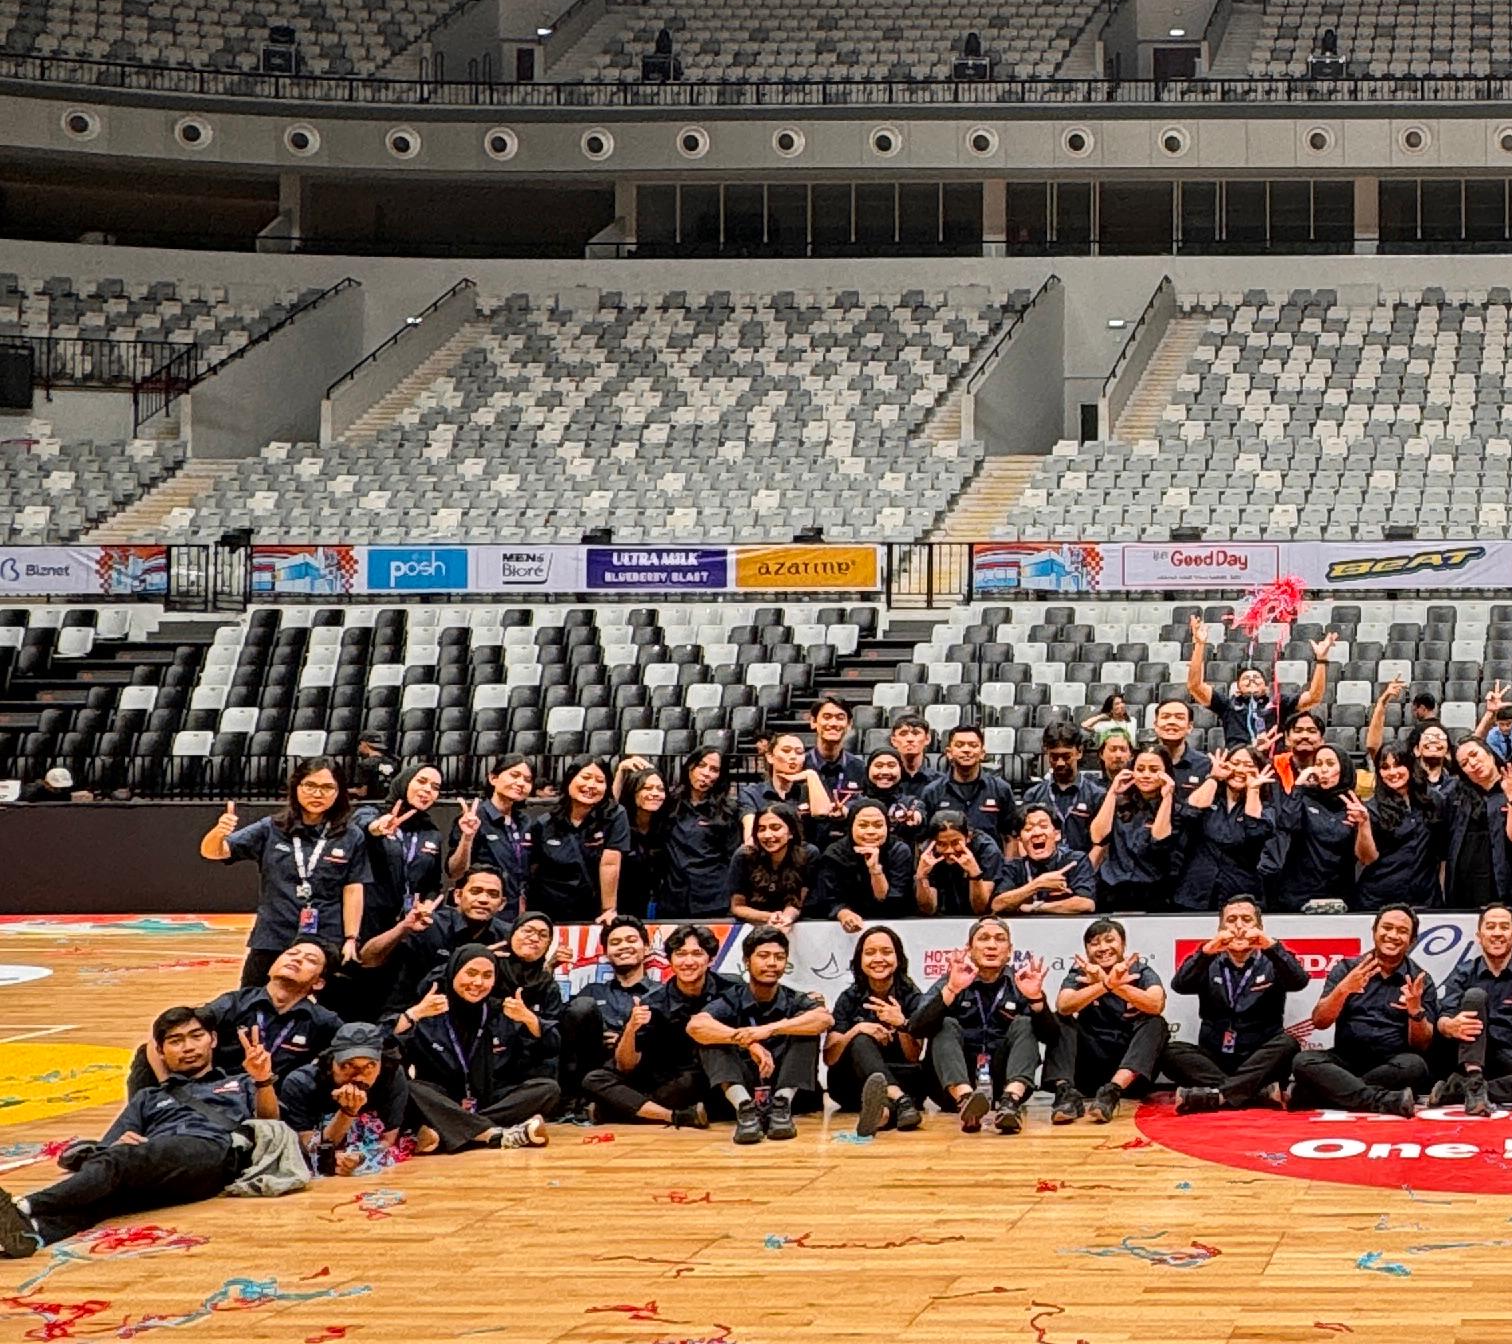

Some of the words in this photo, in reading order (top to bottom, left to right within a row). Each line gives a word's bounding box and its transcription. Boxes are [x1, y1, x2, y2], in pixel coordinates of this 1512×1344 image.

[389, 551, 446, 587] posh
[612, 552, 660, 566] ULTRA
[660, 552, 699, 566] MILK
[757, 559, 852, 576] azarine
[1170, 550, 1214, 568] Good
[1216, 550, 1248, 571] Day
[1289, 1137, 1481, 1160] One
